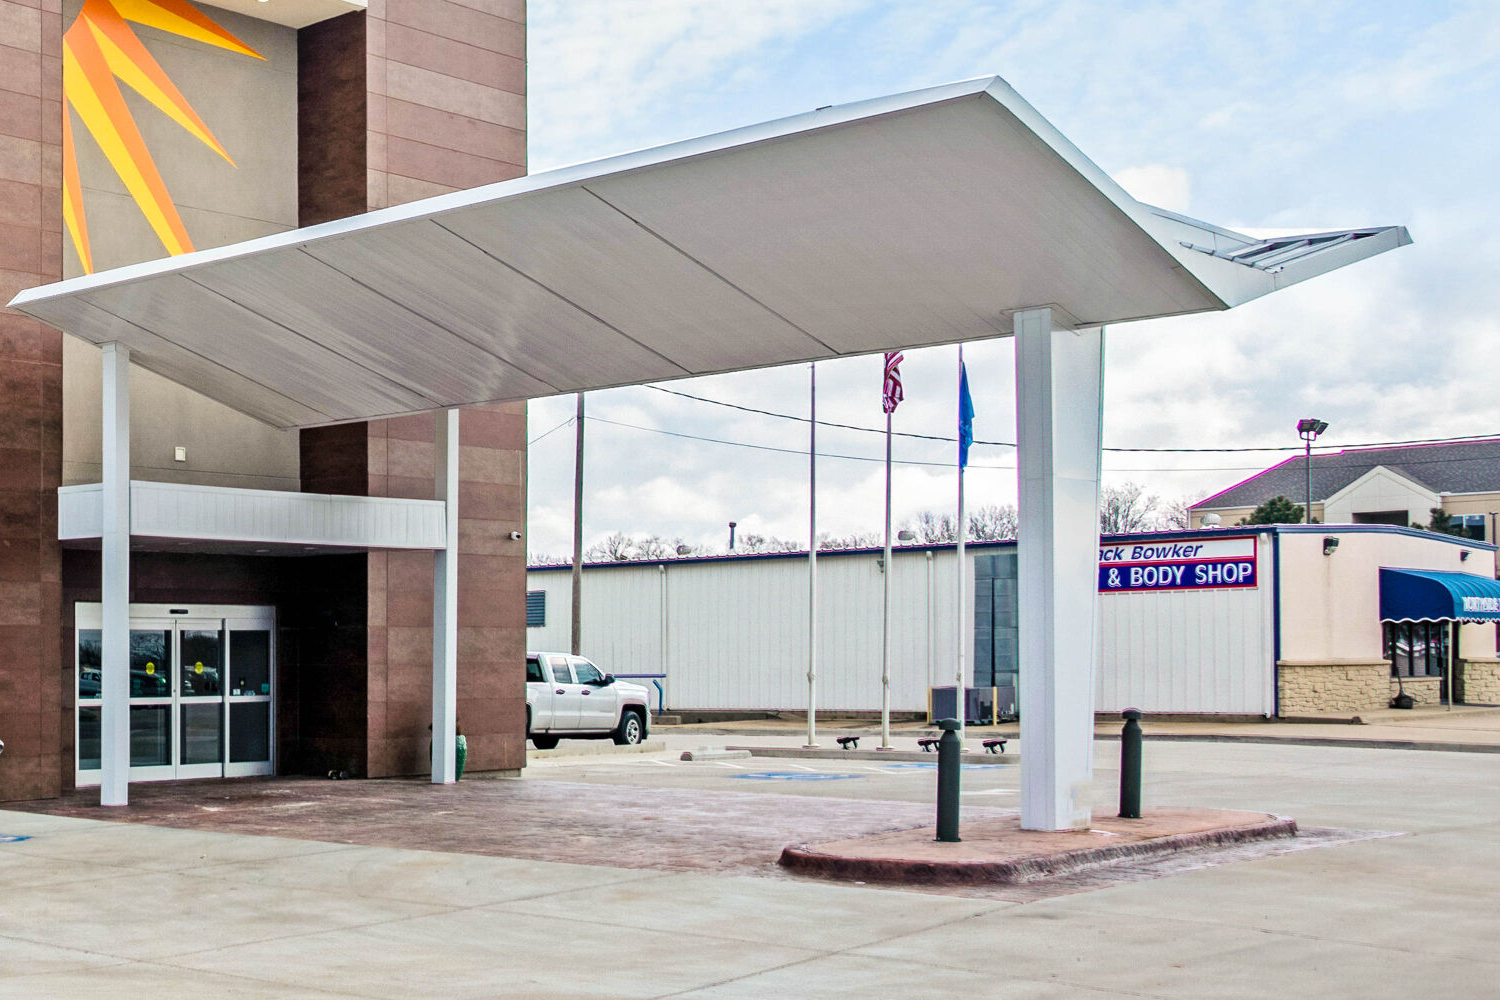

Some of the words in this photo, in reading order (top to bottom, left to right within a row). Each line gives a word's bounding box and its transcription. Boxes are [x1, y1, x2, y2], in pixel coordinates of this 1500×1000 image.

[1131, 543, 1203, 560] Bowker
[1107, 567, 1122, 587] &
[1130, 565, 1185, 587] BODY
[1195, 563, 1252, 585] SHOP
